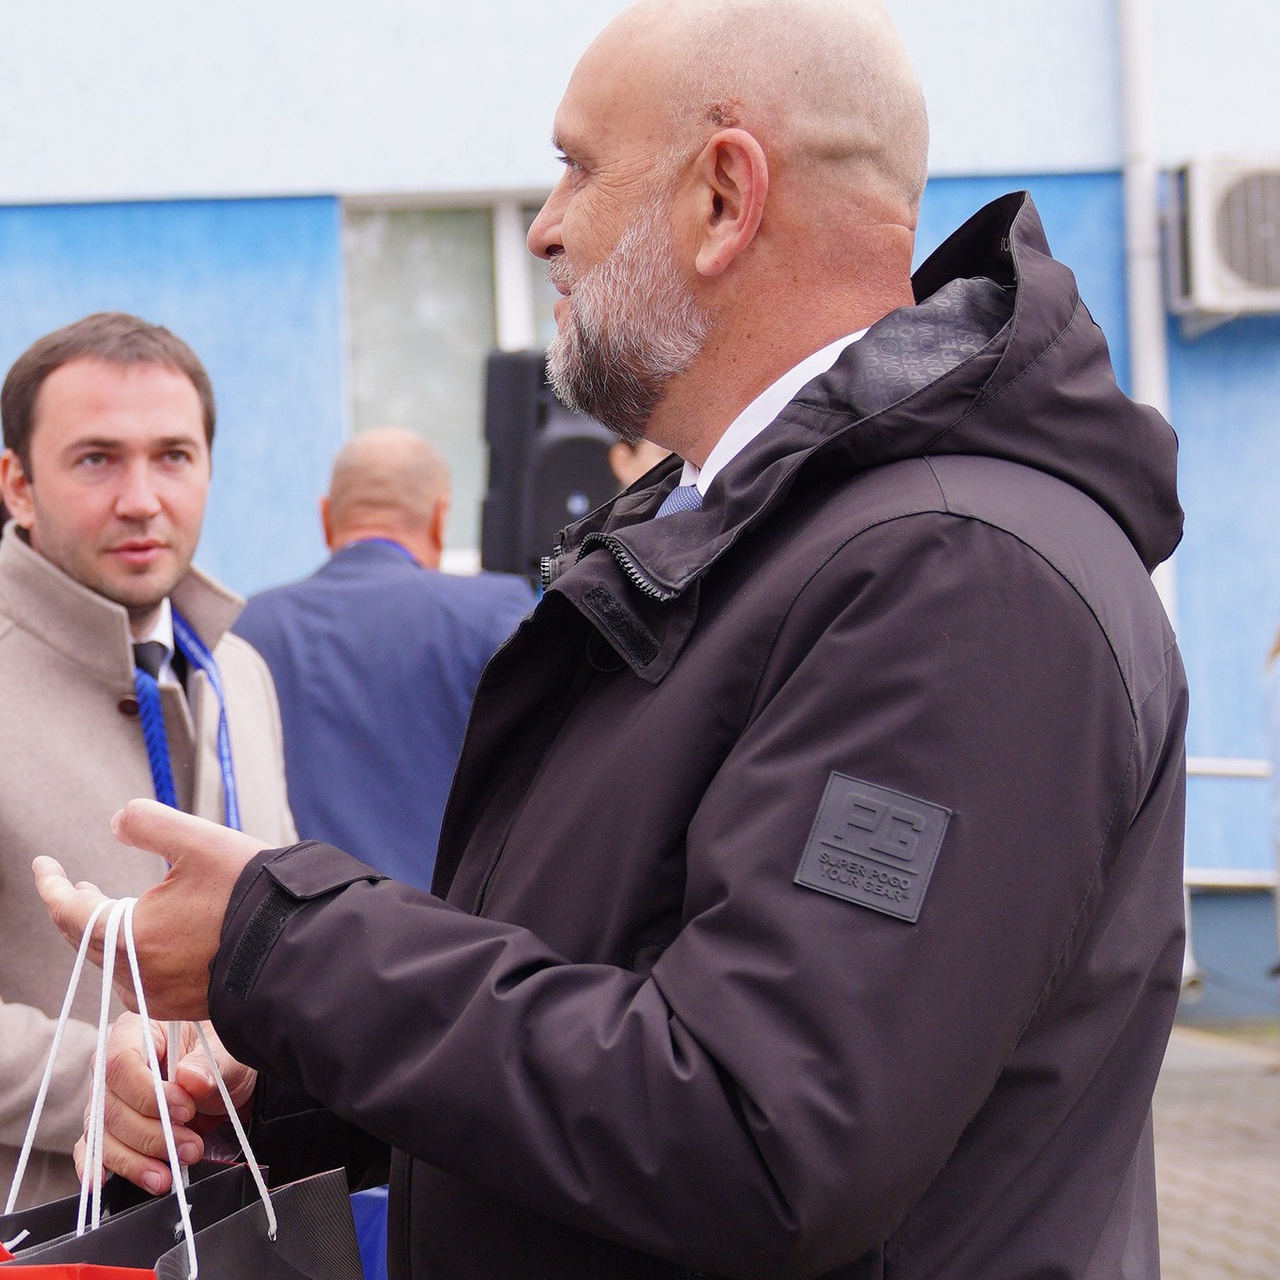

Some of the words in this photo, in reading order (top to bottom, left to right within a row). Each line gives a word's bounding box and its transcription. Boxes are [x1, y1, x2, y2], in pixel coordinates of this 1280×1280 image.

[819, 852, 867, 878] SUPER
[868, 868, 911, 891] POGO
[821, 864, 859, 889] YOUR
